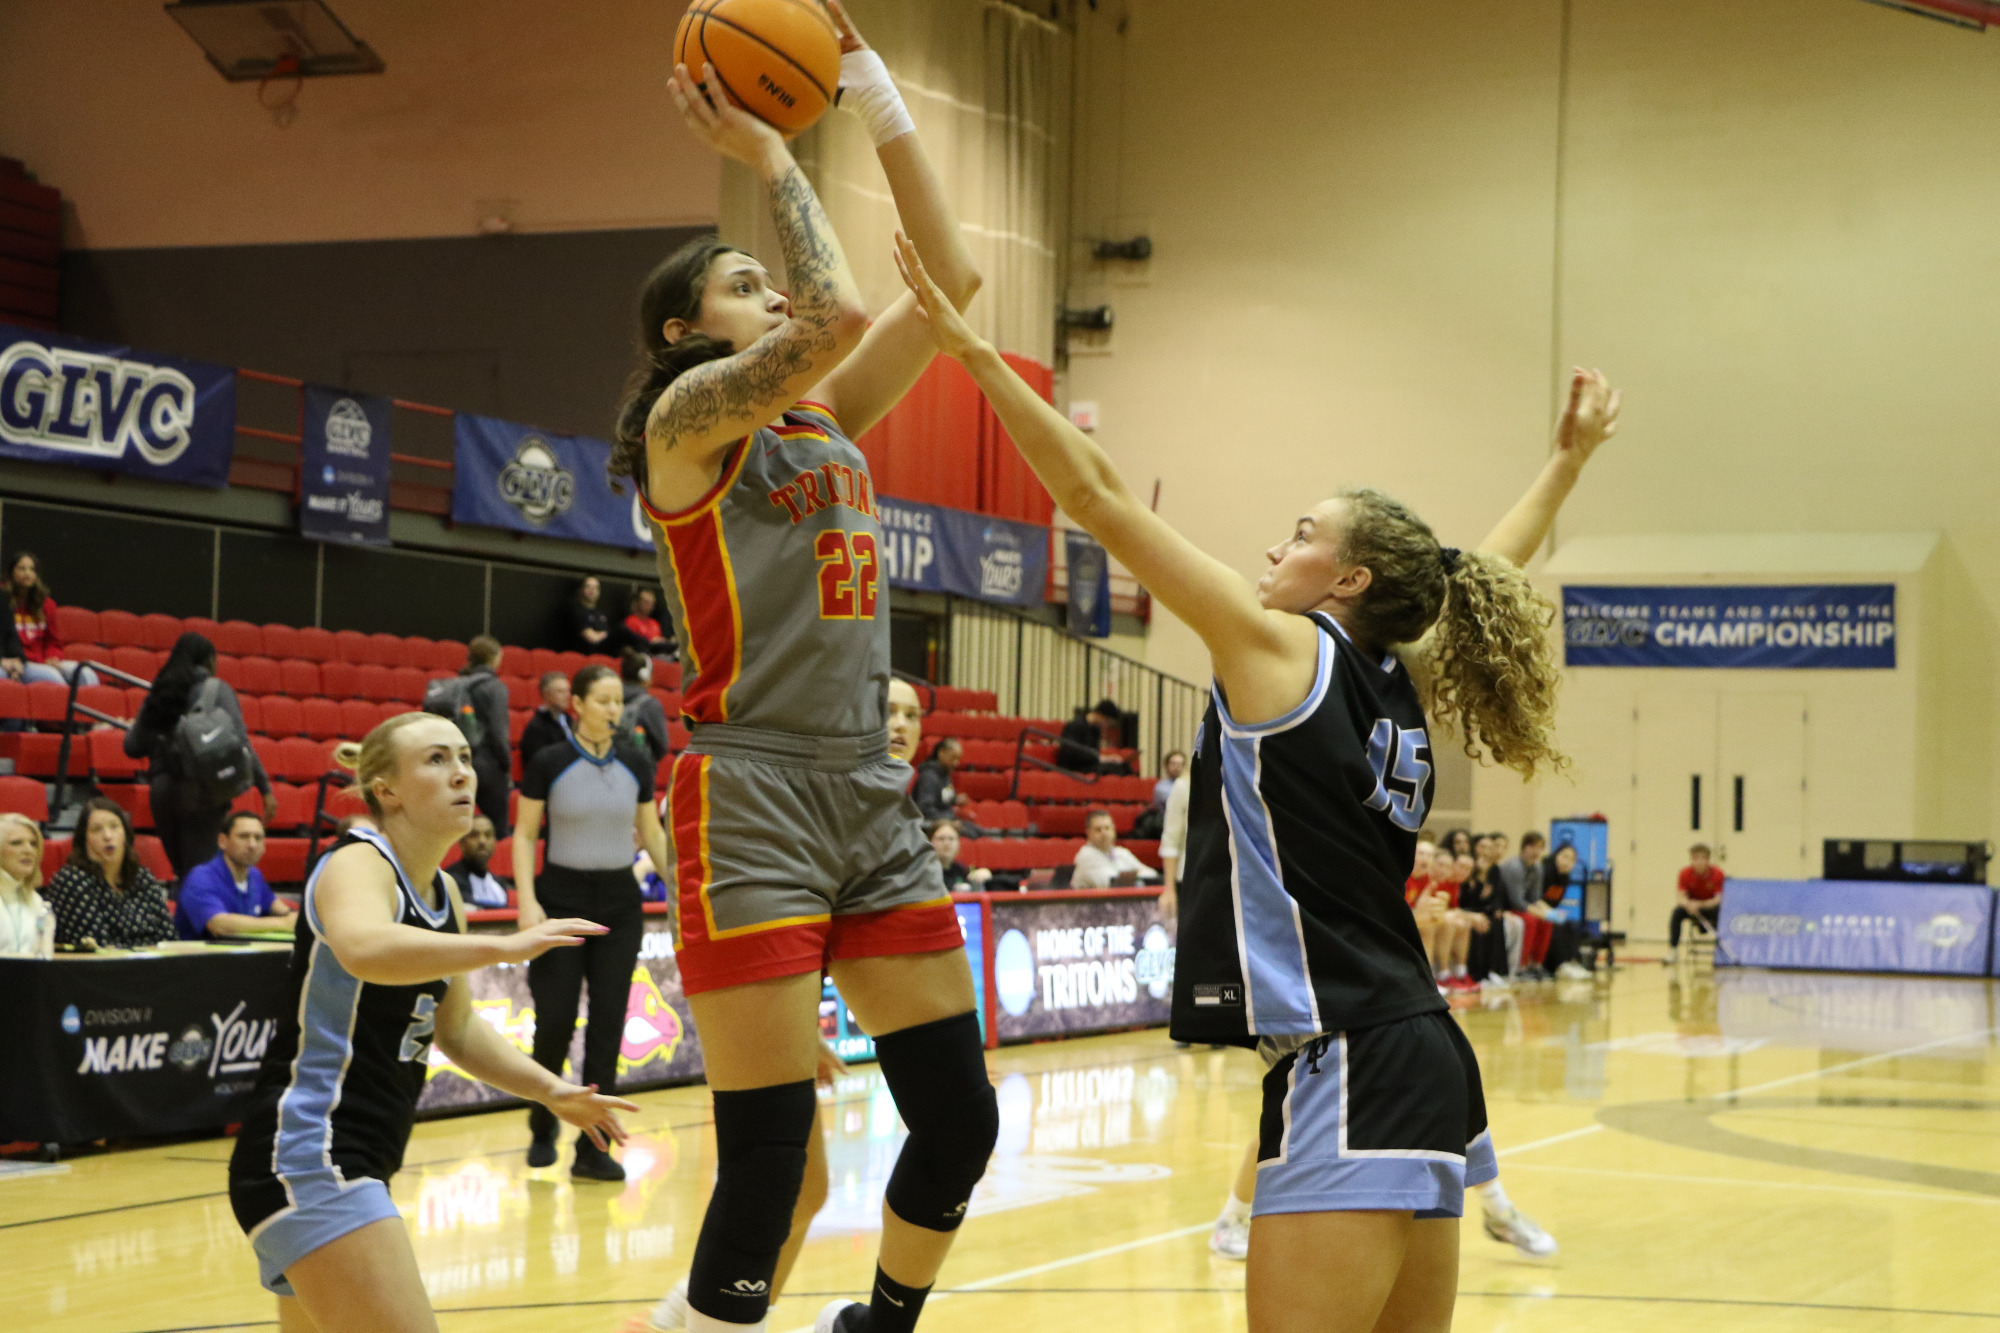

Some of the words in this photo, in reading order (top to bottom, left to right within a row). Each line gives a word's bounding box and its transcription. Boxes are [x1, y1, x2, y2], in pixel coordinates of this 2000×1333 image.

[0, 341, 195, 465] GLVC
[814, 529, 879, 620] 22
[1567, 605, 1649, 618] WELCOME
[1659, 605, 1716, 619] TEAMS
[1724, 605, 1762, 619] AND
[1770, 605, 1817, 619] FANS
[1825, 604, 1849, 619] TO
[1858, 604, 1891, 618] THE
[1655, 622, 1895, 647] CHAMPIONSHIP
[1362, 718, 1431, 832] 15
[1037, 928, 1083, 960] HOME
[1084, 927, 1105, 957] OF
[1107, 925, 1135, 956] THE
[1038, 958, 1137, 1010] TRITONS
[1224, 990, 1236, 1001] XL
[84, 1009, 141, 1026] DIVISION
[77, 1032, 170, 1075] MAKE
[208, 1000, 278, 1079] YOU
